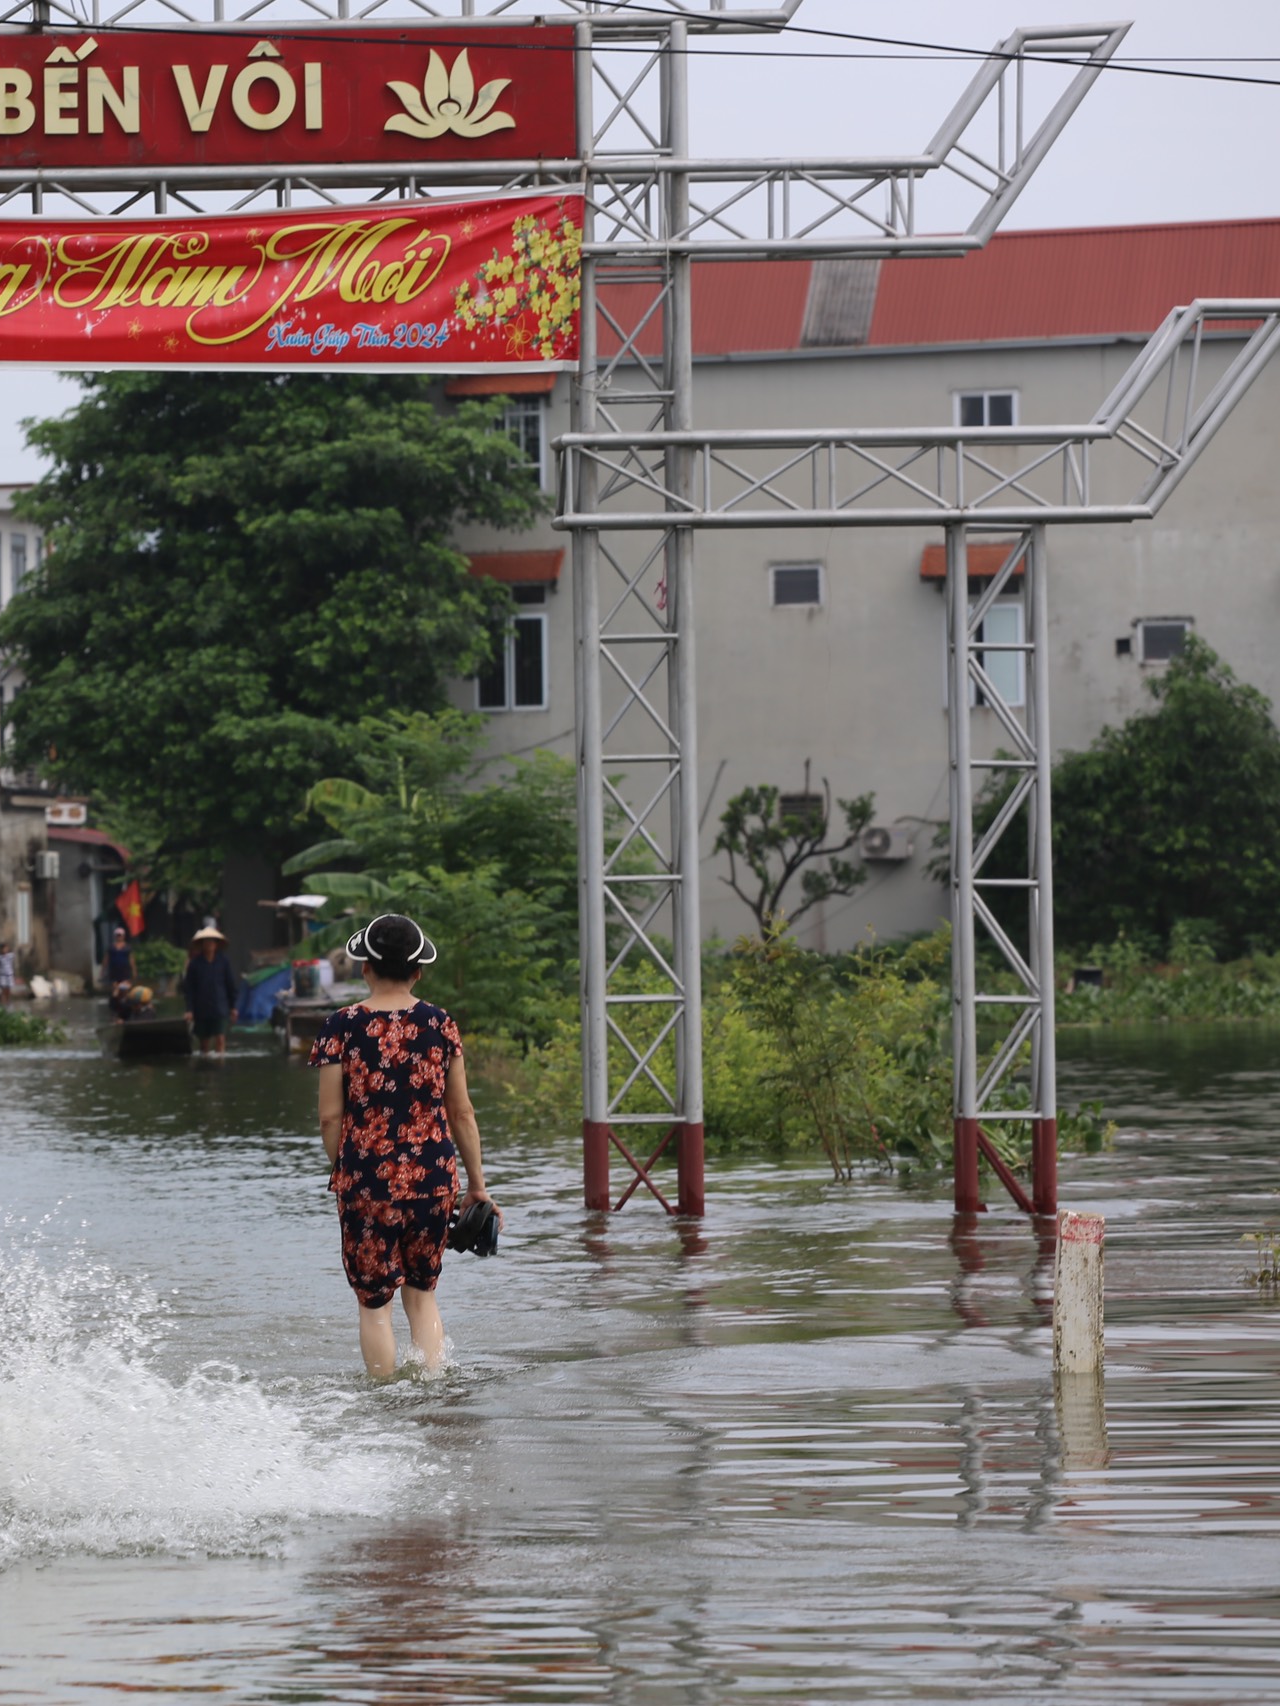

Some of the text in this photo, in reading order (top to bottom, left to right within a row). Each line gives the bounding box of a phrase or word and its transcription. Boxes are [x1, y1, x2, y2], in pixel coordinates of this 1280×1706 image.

[171, 40, 323, 132] VÔI
[186, 217, 451, 346] Mới
[264, 320, 312, 351] Xuân
[391, 318, 450, 348] 2024
